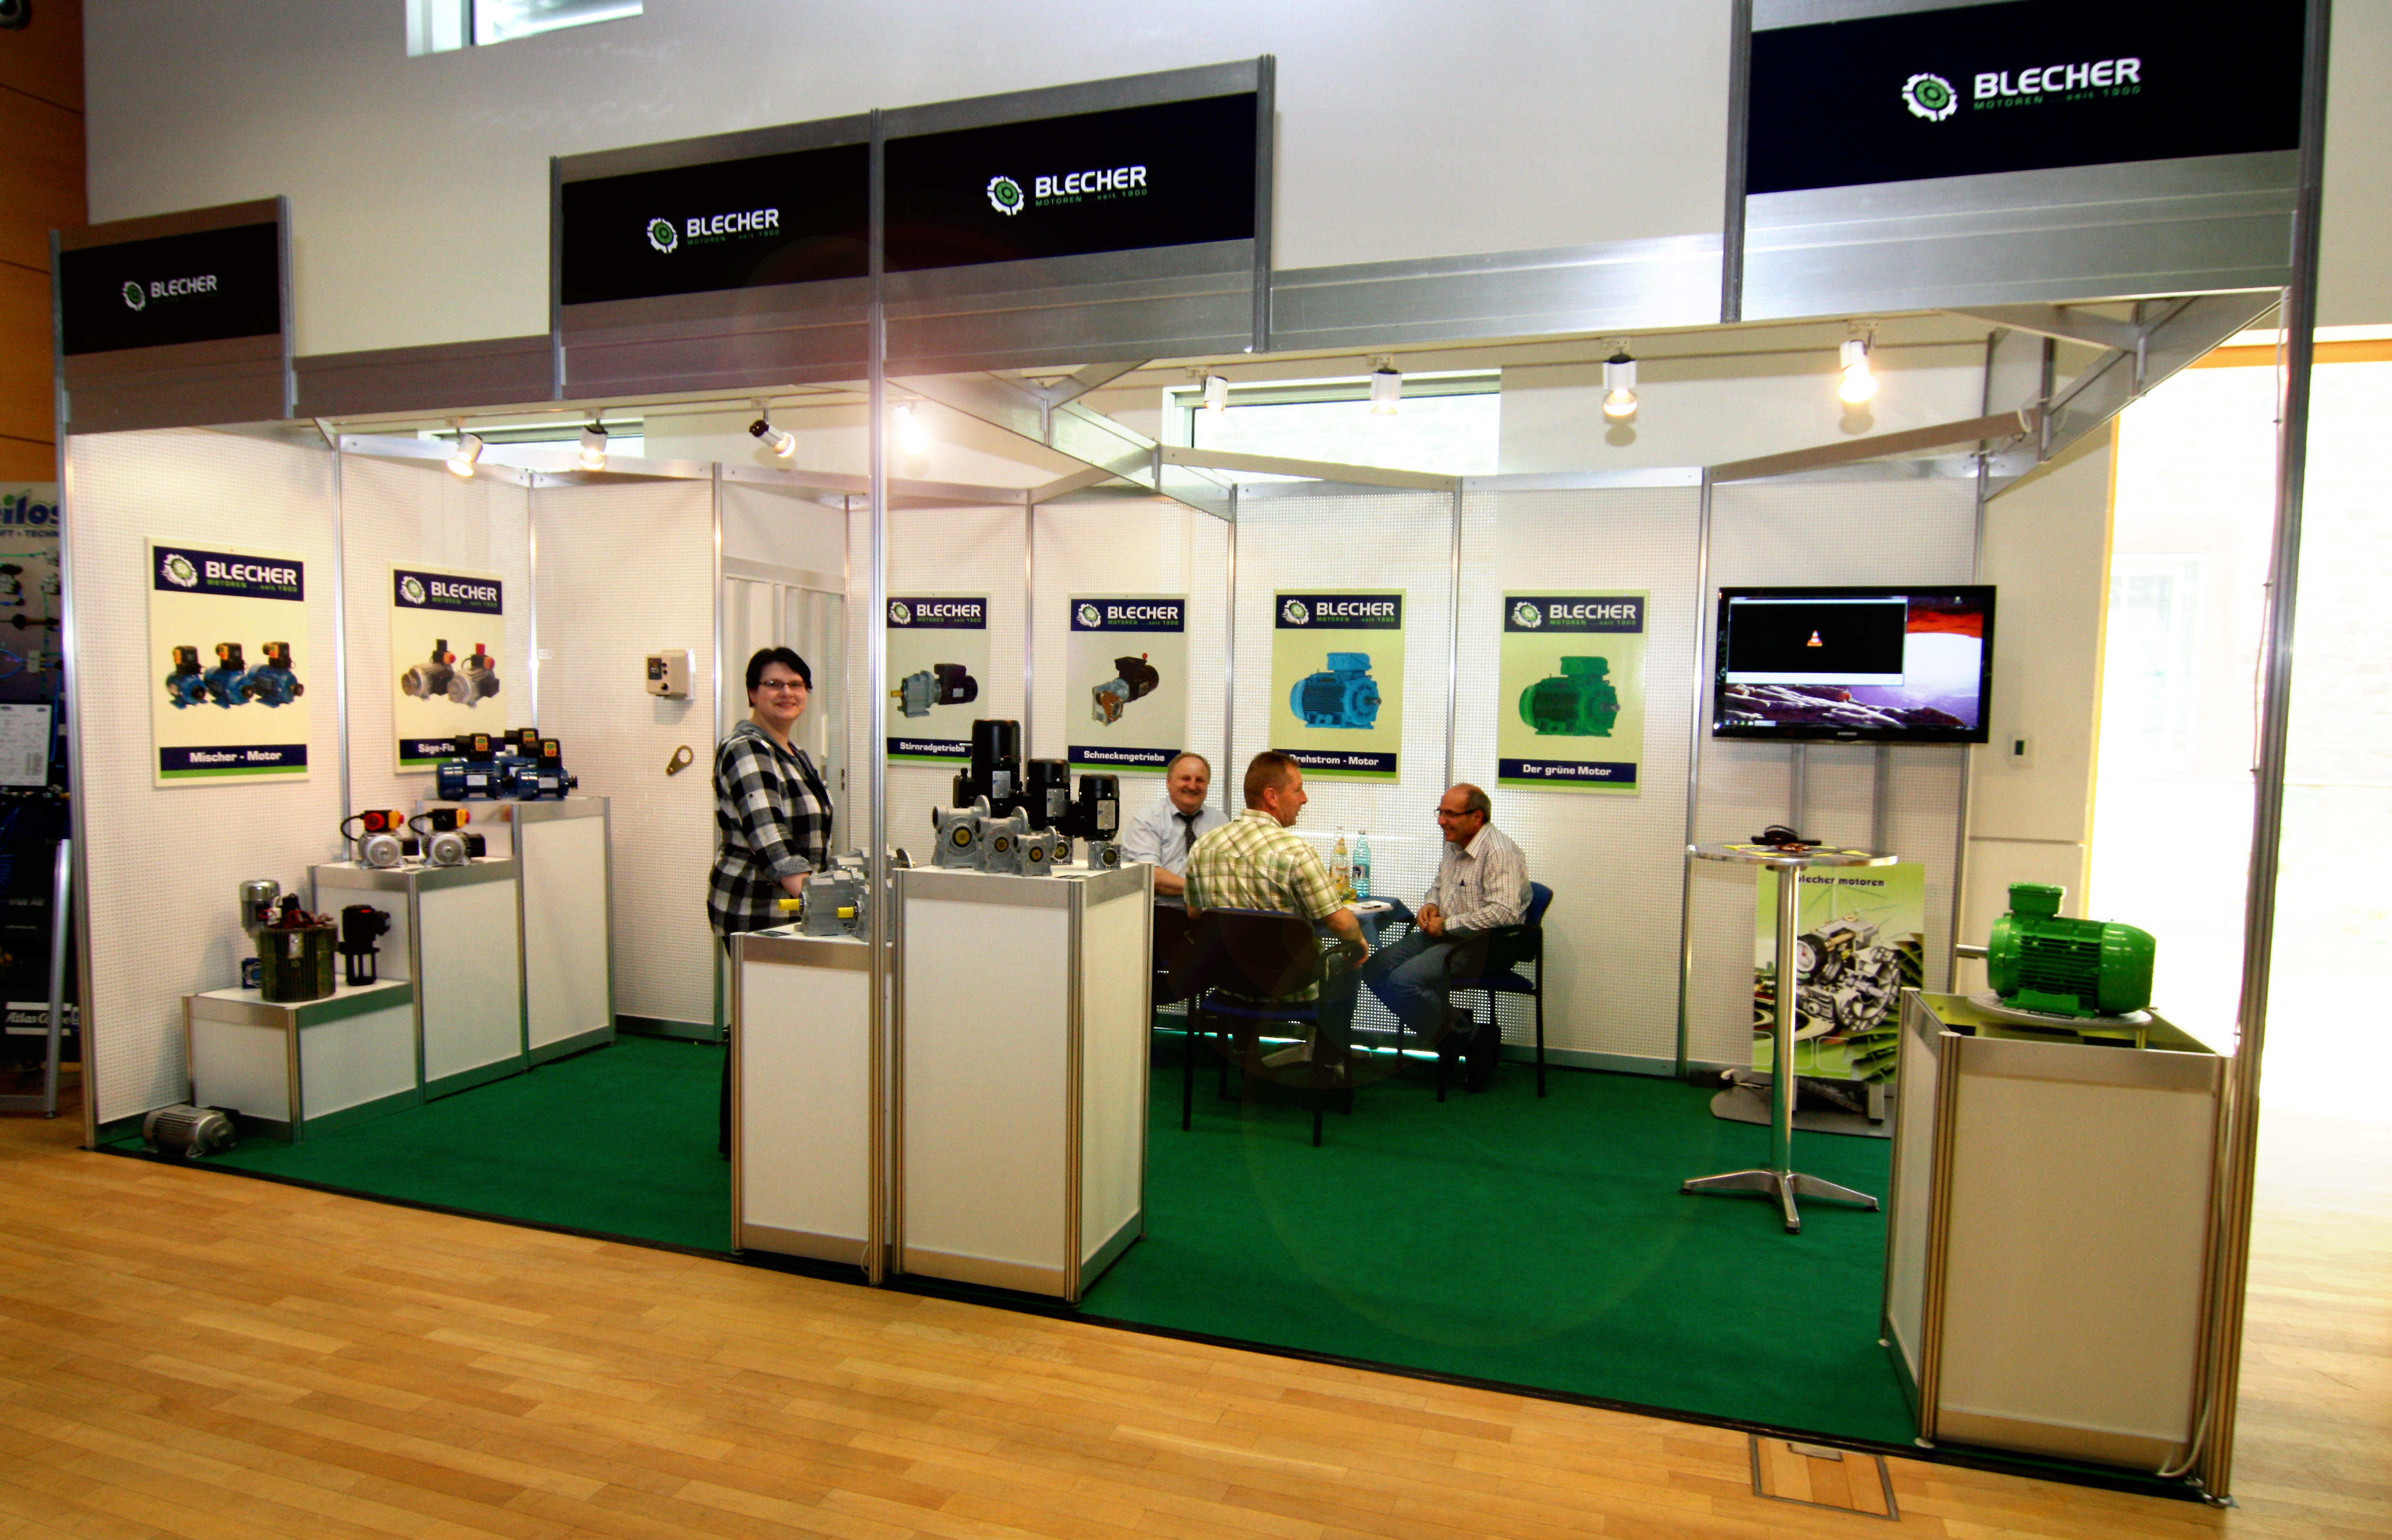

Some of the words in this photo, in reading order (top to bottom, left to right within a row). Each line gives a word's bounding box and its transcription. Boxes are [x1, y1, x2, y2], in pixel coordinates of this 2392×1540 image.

[1974, 58, 2141, 100] BLECHER
[1973, 95, 2044, 111] MOTOREN
[1035, 165, 1147, 198] BLECHER
[1035, 195, 1082, 207] MOTOREN
[1122, 188, 1148, 198] 1900
[687, 208, 779, 238] BLECHER
[687, 236, 726, 245] MOTOREN
[151, 275, 218, 298] BLECHER
[0, 493, 59, 525] ilos
[205, 560, 298, 585] BLECHER
[431, 581, 497, 602] BLECHER
[916, 604, 981, 617] BLECHER
[1107, 606, 1178, 619] BLECHER
[1316, 602, 1395, 616] BLECHER
[1550, 604, 1637, 619] BLECHER
[900, 742, 965, 753] Stirnradgetriebe
[189, 751, 238, 763] Mischer
[246, 750, 282, 761] Motor
[1084, 750, 1165, 762] Schneckengetriebe
[1348, 756, 1379, 766] Motor
[1523, 764, 1543, 773] Der
[1545, 765, 1575, 776] grüne
[1577, 766, 1612, 775] Motor
[1798, 875, 1835, 885] lecher
[1838, 878, 1885, 886] motoren
